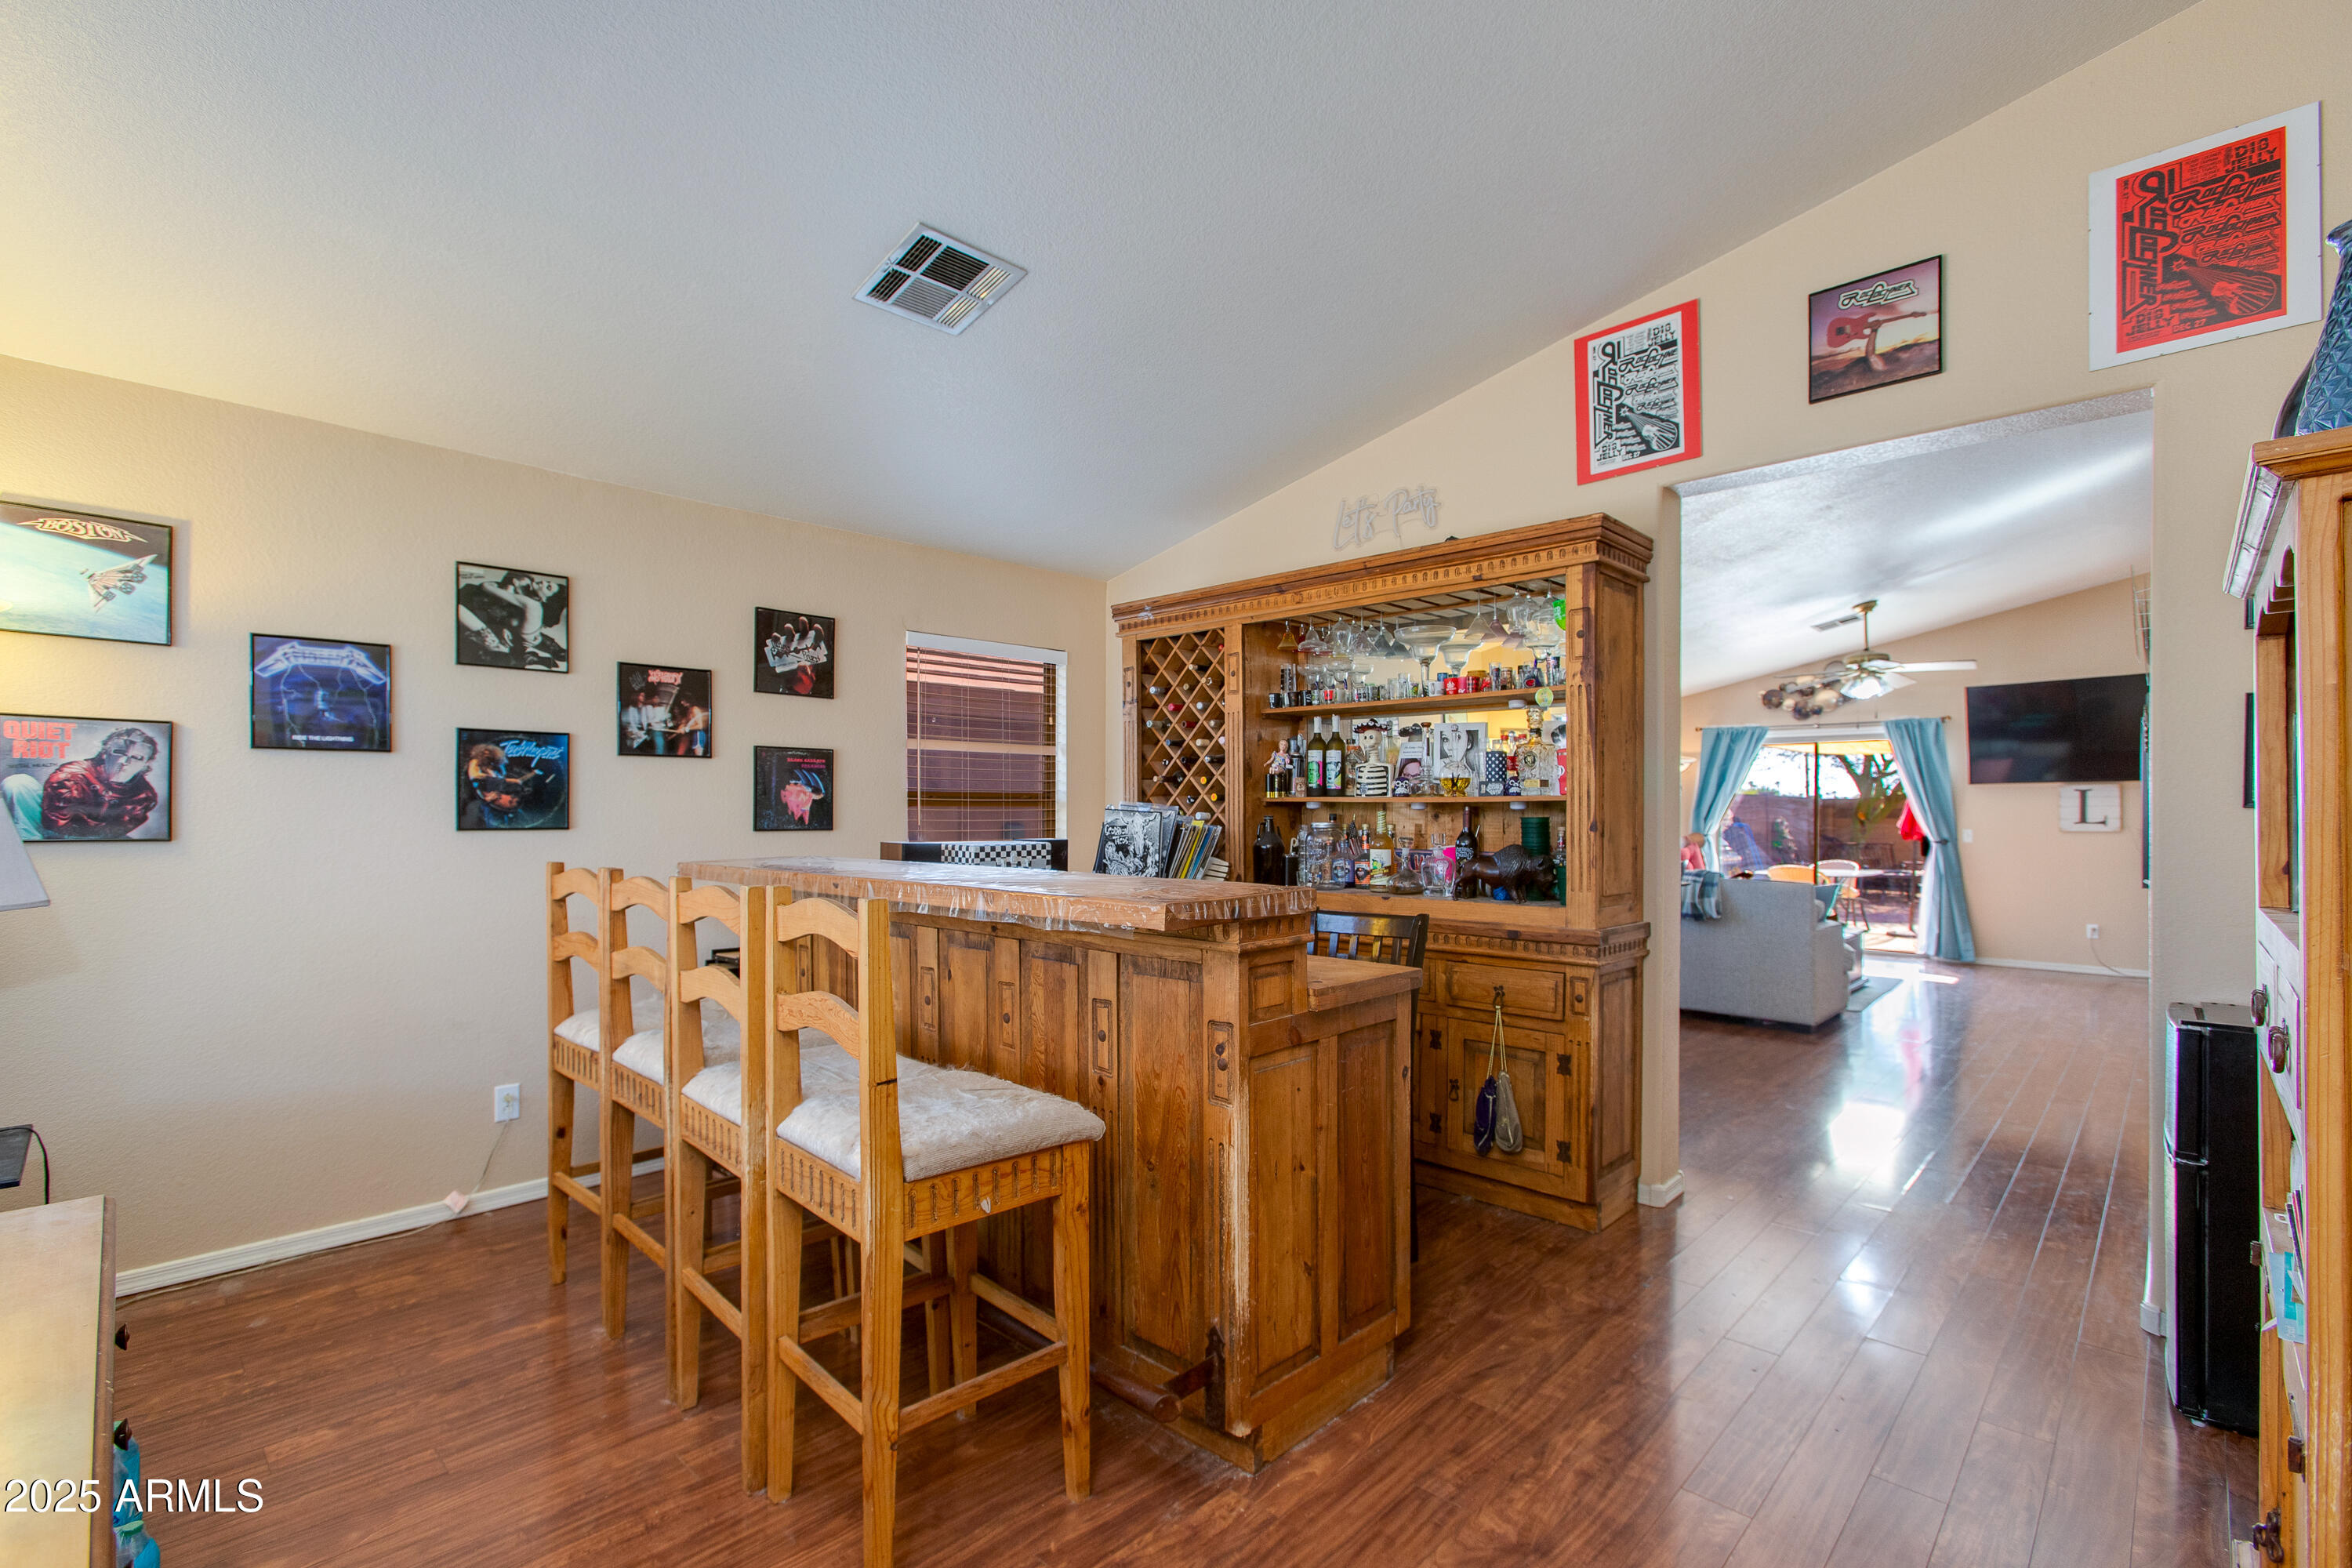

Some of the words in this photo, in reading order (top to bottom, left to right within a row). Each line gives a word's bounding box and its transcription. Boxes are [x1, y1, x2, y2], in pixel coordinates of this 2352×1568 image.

[2234, 137, 2269, 158] DIG
[2225, 147, 2278, 172] JELLY
[1653, 322, 1671, 336] DIG
[2172, 322, 2191, 333] DEC
[1648, 330, 1675, 347] JELLY
[1384, 485, 1442, 539] Party
[42, 518, 127, 541] BOSTON
[3, 720, 77, 741] QUIET
[12, 739, 71, 759] RIOT
[2074, 789, 2107, 826] L
